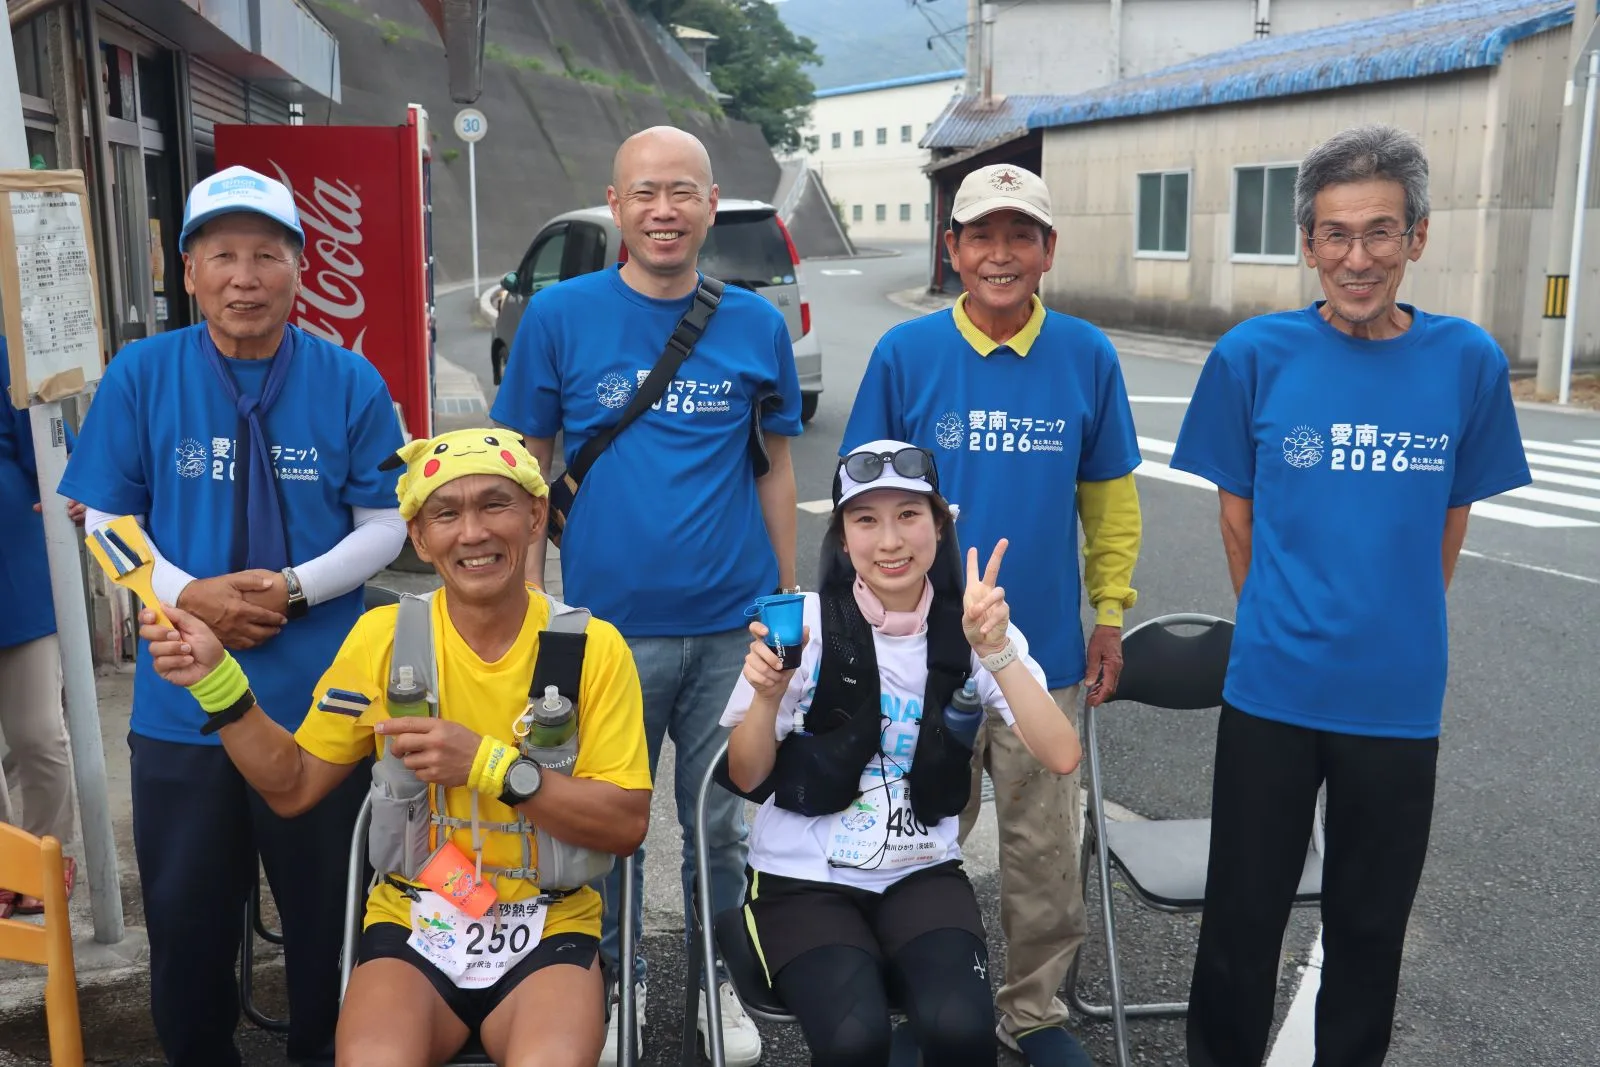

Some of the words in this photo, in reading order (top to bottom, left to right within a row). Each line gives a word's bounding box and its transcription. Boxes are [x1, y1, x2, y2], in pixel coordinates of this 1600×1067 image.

[463, 118, 480, 133] 30
[212, 437, 318, 462] 愛ラニック
[969, 432, 1031, 453] 2026
[1331, 448, 1409, 472] 2026
[465, 922, 530, 955] 250
